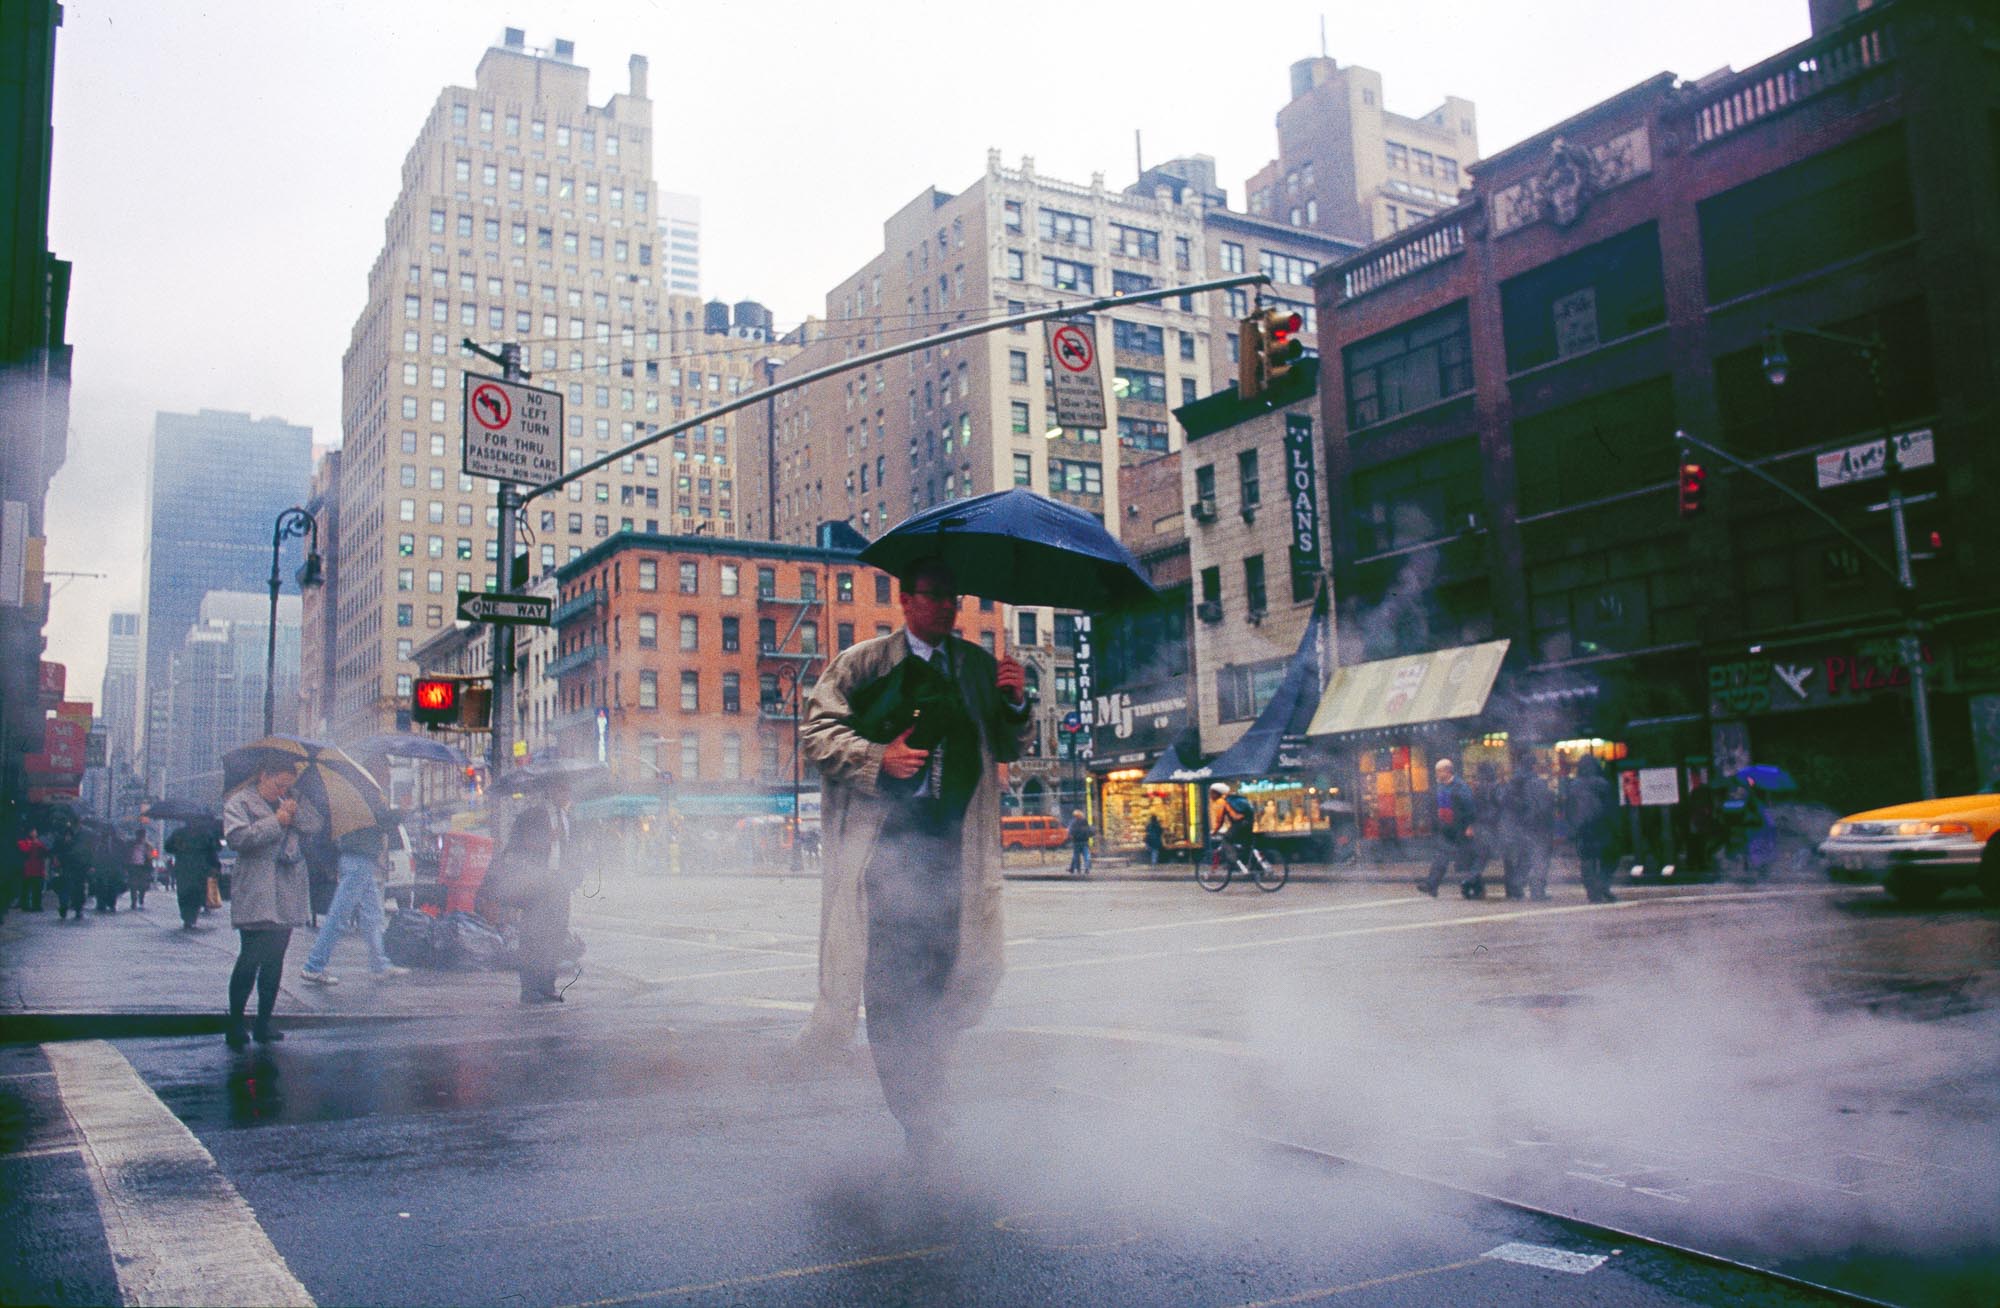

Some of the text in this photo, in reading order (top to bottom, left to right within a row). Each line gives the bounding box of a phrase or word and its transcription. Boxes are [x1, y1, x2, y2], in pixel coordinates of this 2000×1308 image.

[527, 392, 543, 405] NO
[521, 407, 548, 421] LEFT
[520, 420, 550, 436] TURN
[484, 432, 545, 455] FOR THRU
[469, 444, 557, 472] PASSENGER CARS
[1292, 449, 1313, 552] LOANS
[472, 601, 545, 617] ONE WAY
